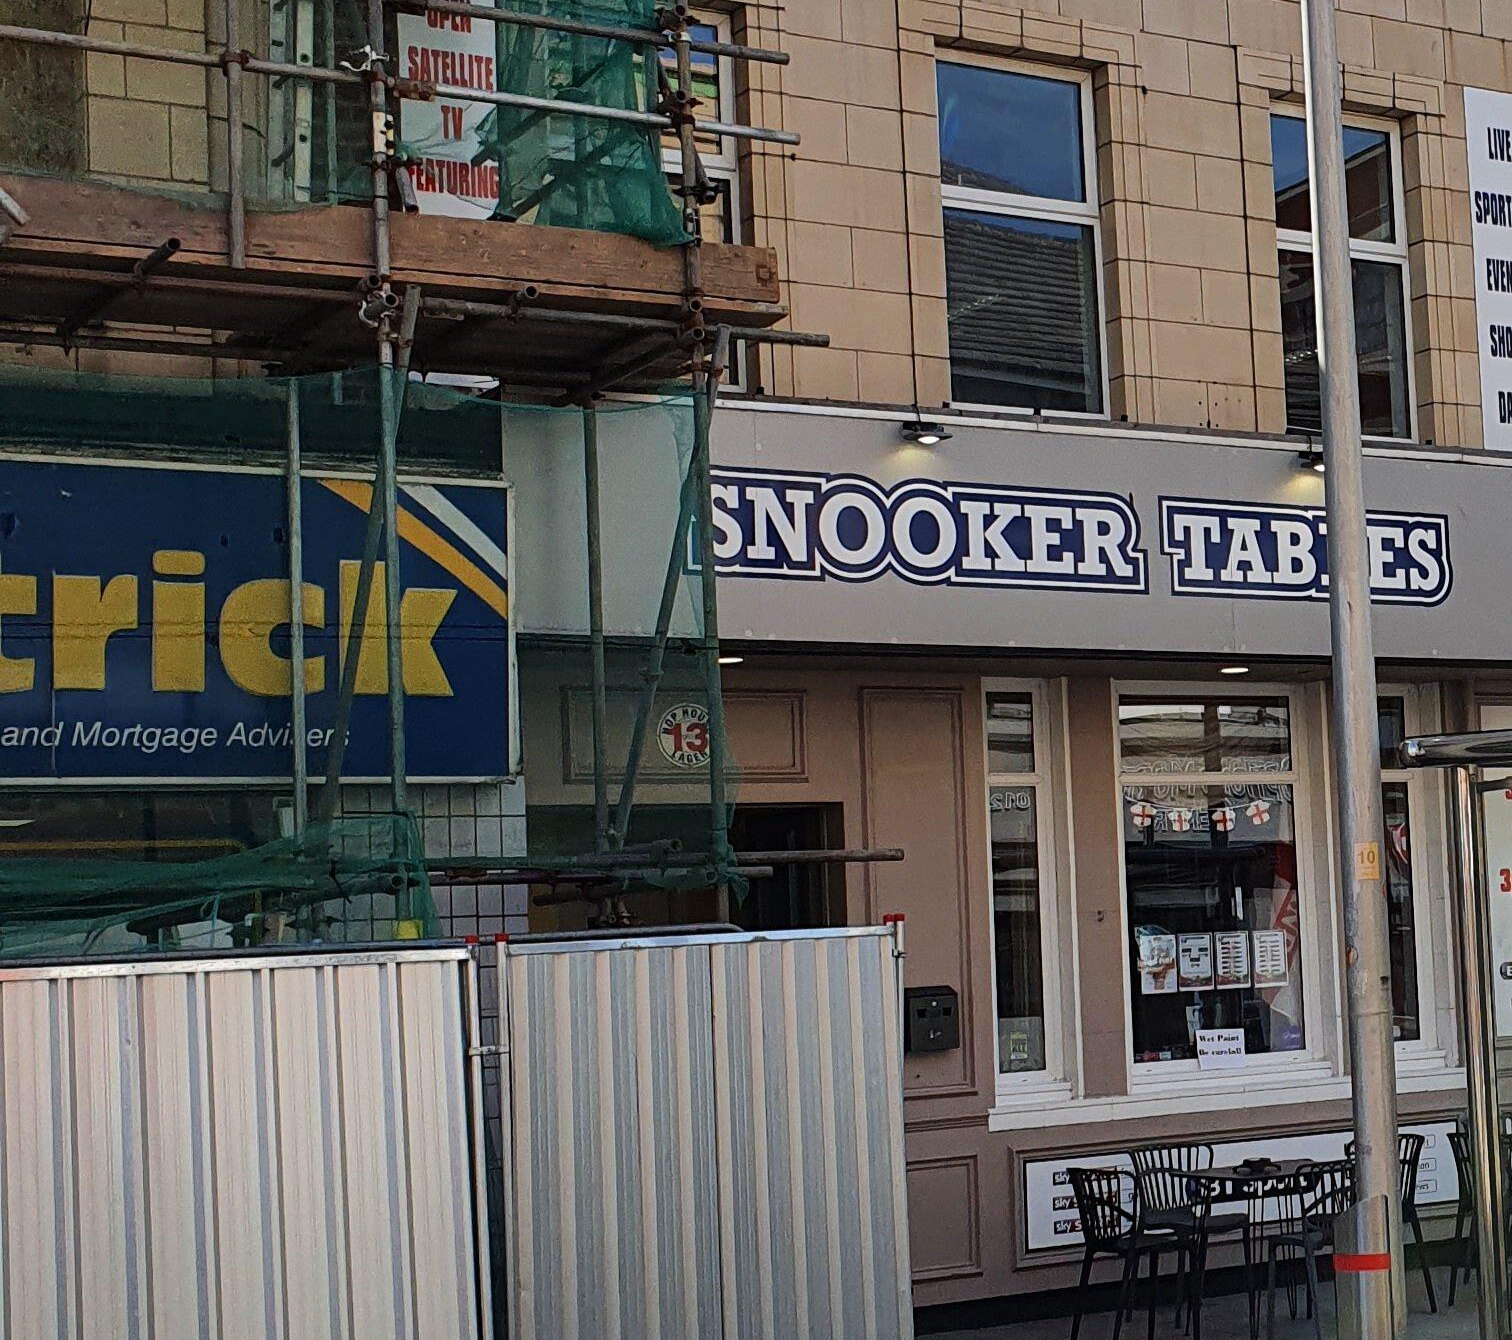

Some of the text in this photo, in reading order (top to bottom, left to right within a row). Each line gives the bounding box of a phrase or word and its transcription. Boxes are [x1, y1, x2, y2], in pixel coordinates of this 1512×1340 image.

[408, 45, 494, 94] SATELLITE
[441, 104, 464, 141] TV
[1487, 126, 1512, 162] LIVE
[407, 158, 500, 200] FEATURING
[711, 480, 1440, 594] SNOOKER TABES
[681, 707, 706, 722] HOU
[2, 721, 350, 753] and Mortgage Advier
[673, 722, 709, 754] 13
[1358, 850, 1376, 864] 10
[1217, 1034, 1240, 1042] Paint
[1055, 1197, 1071, 1210] sky
[1056, 1220, 1071, 1233] sky
